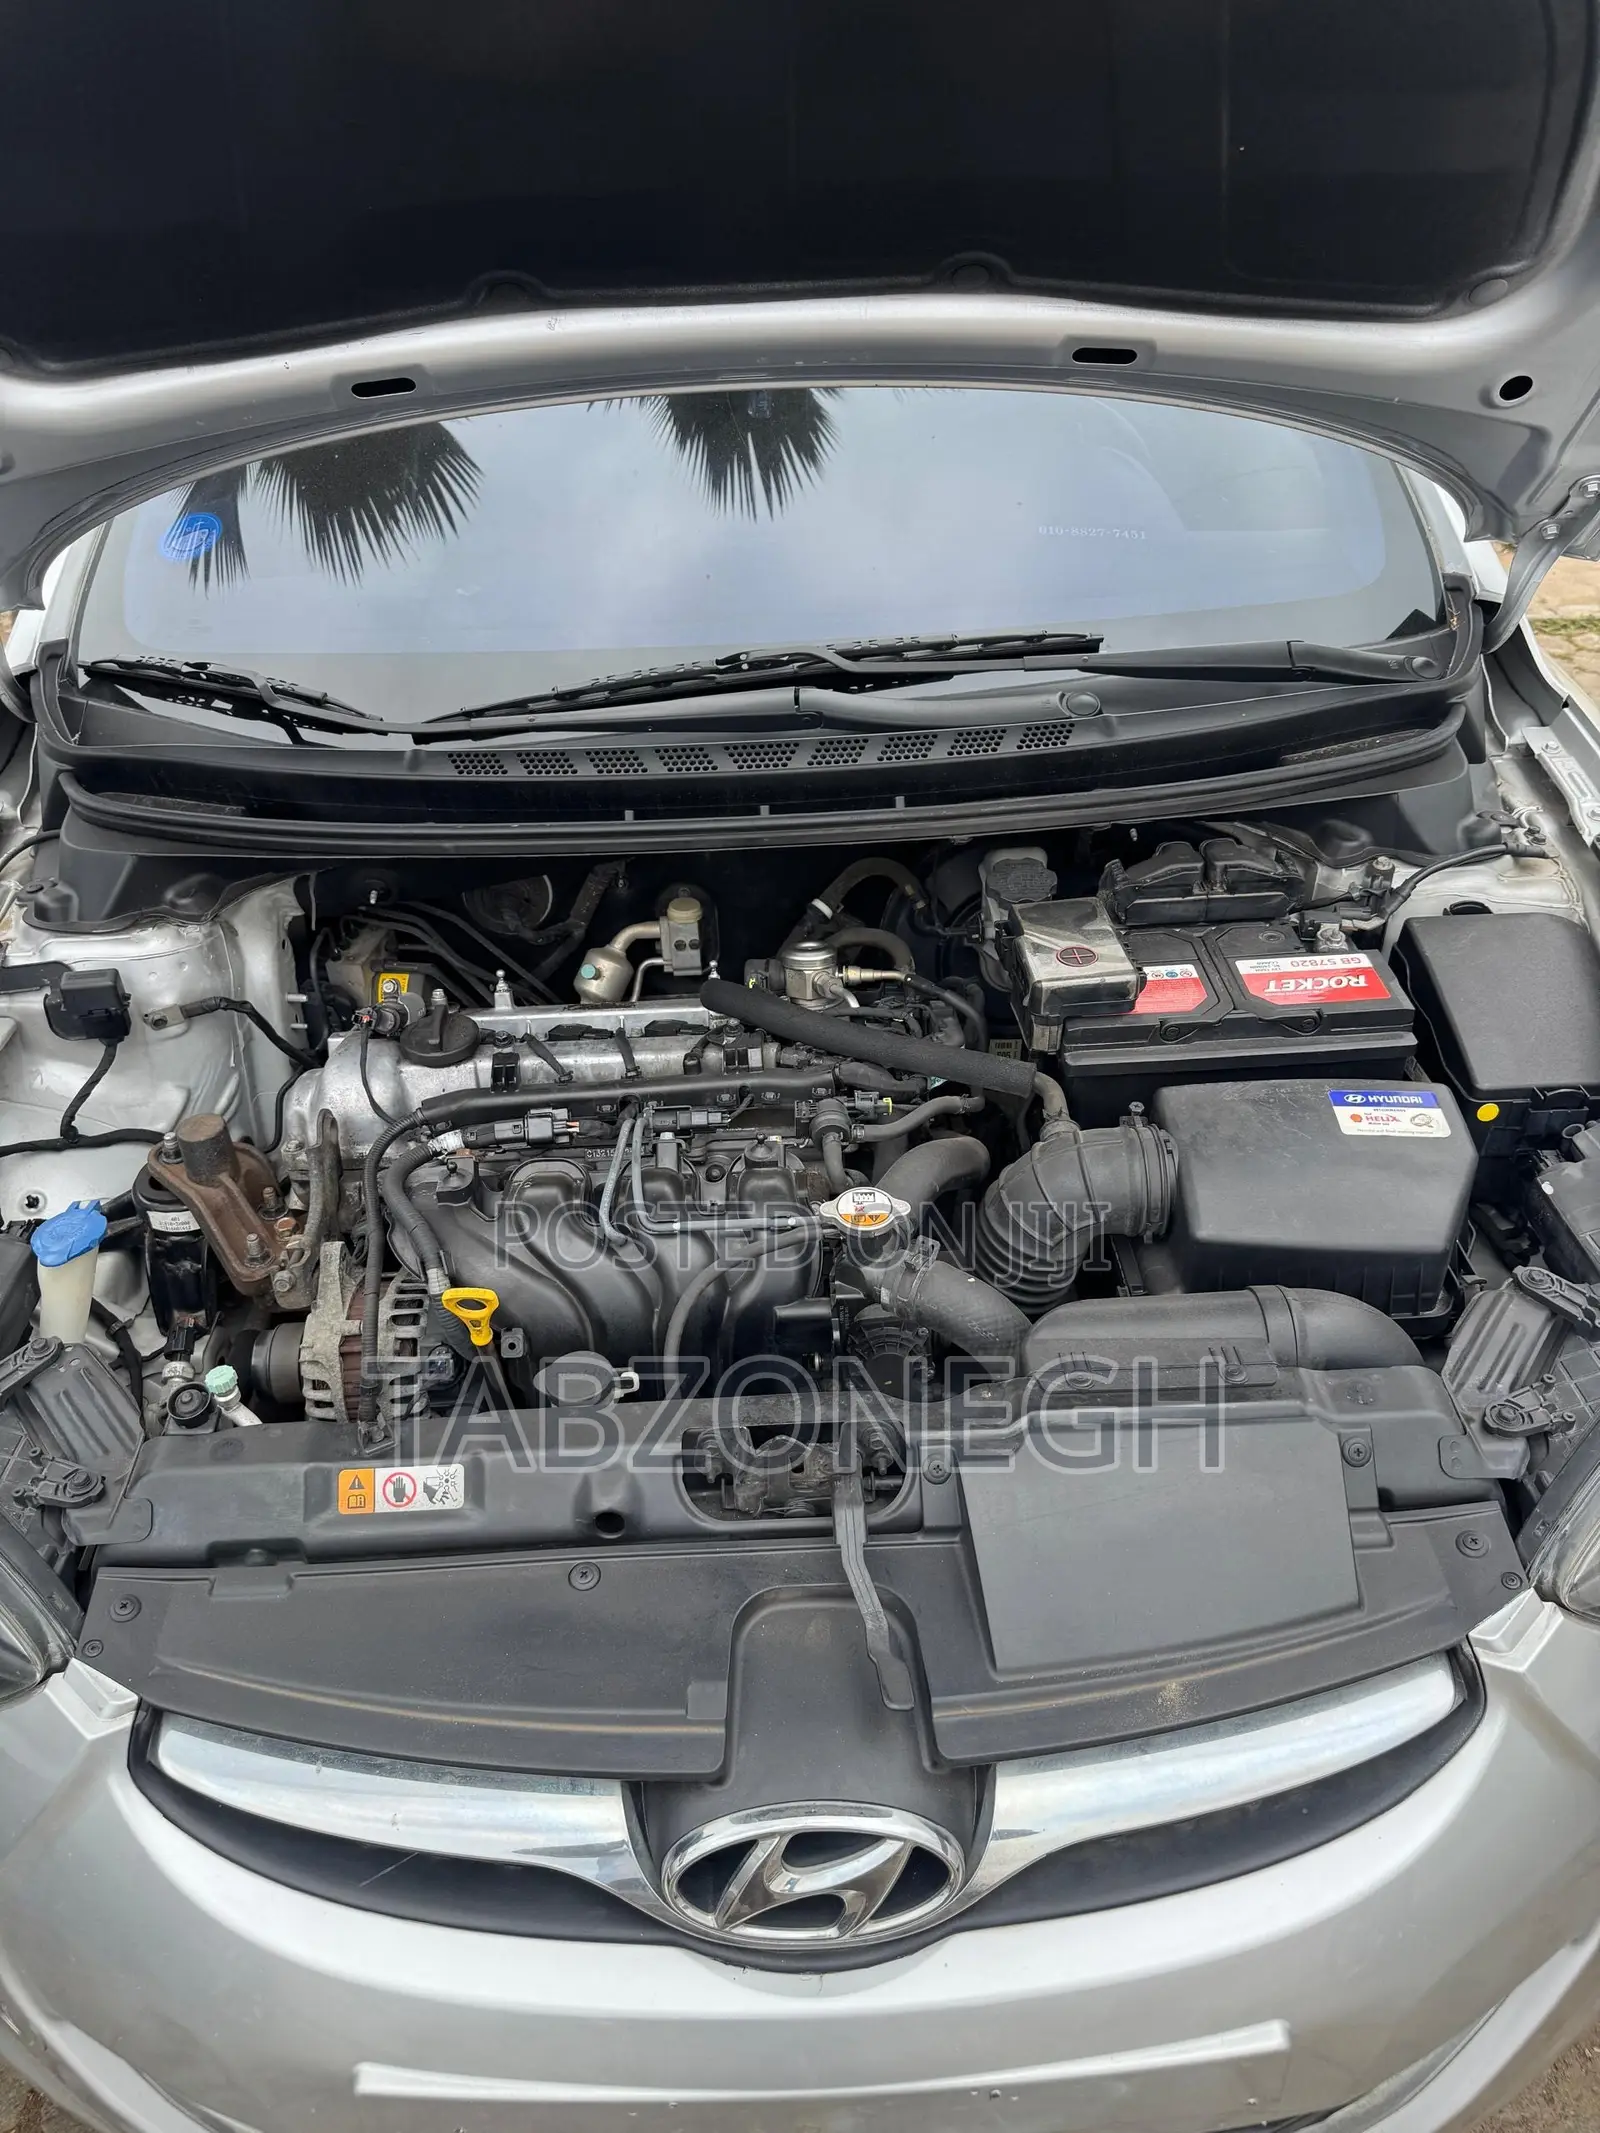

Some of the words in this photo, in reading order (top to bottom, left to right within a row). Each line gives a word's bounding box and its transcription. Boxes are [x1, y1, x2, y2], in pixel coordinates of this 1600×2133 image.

[1038, 525, 1147, 540] 010-8827-7451
[1290, 957, 1337, 968] 57820
[1340, 957, 1362, 965] GB
[1264, 974, 1369, 991] ROCKET
[1367, 1095, 1424, 1105] HYUNDAI
[1364, 1115, 1400, 1123] HELIX
